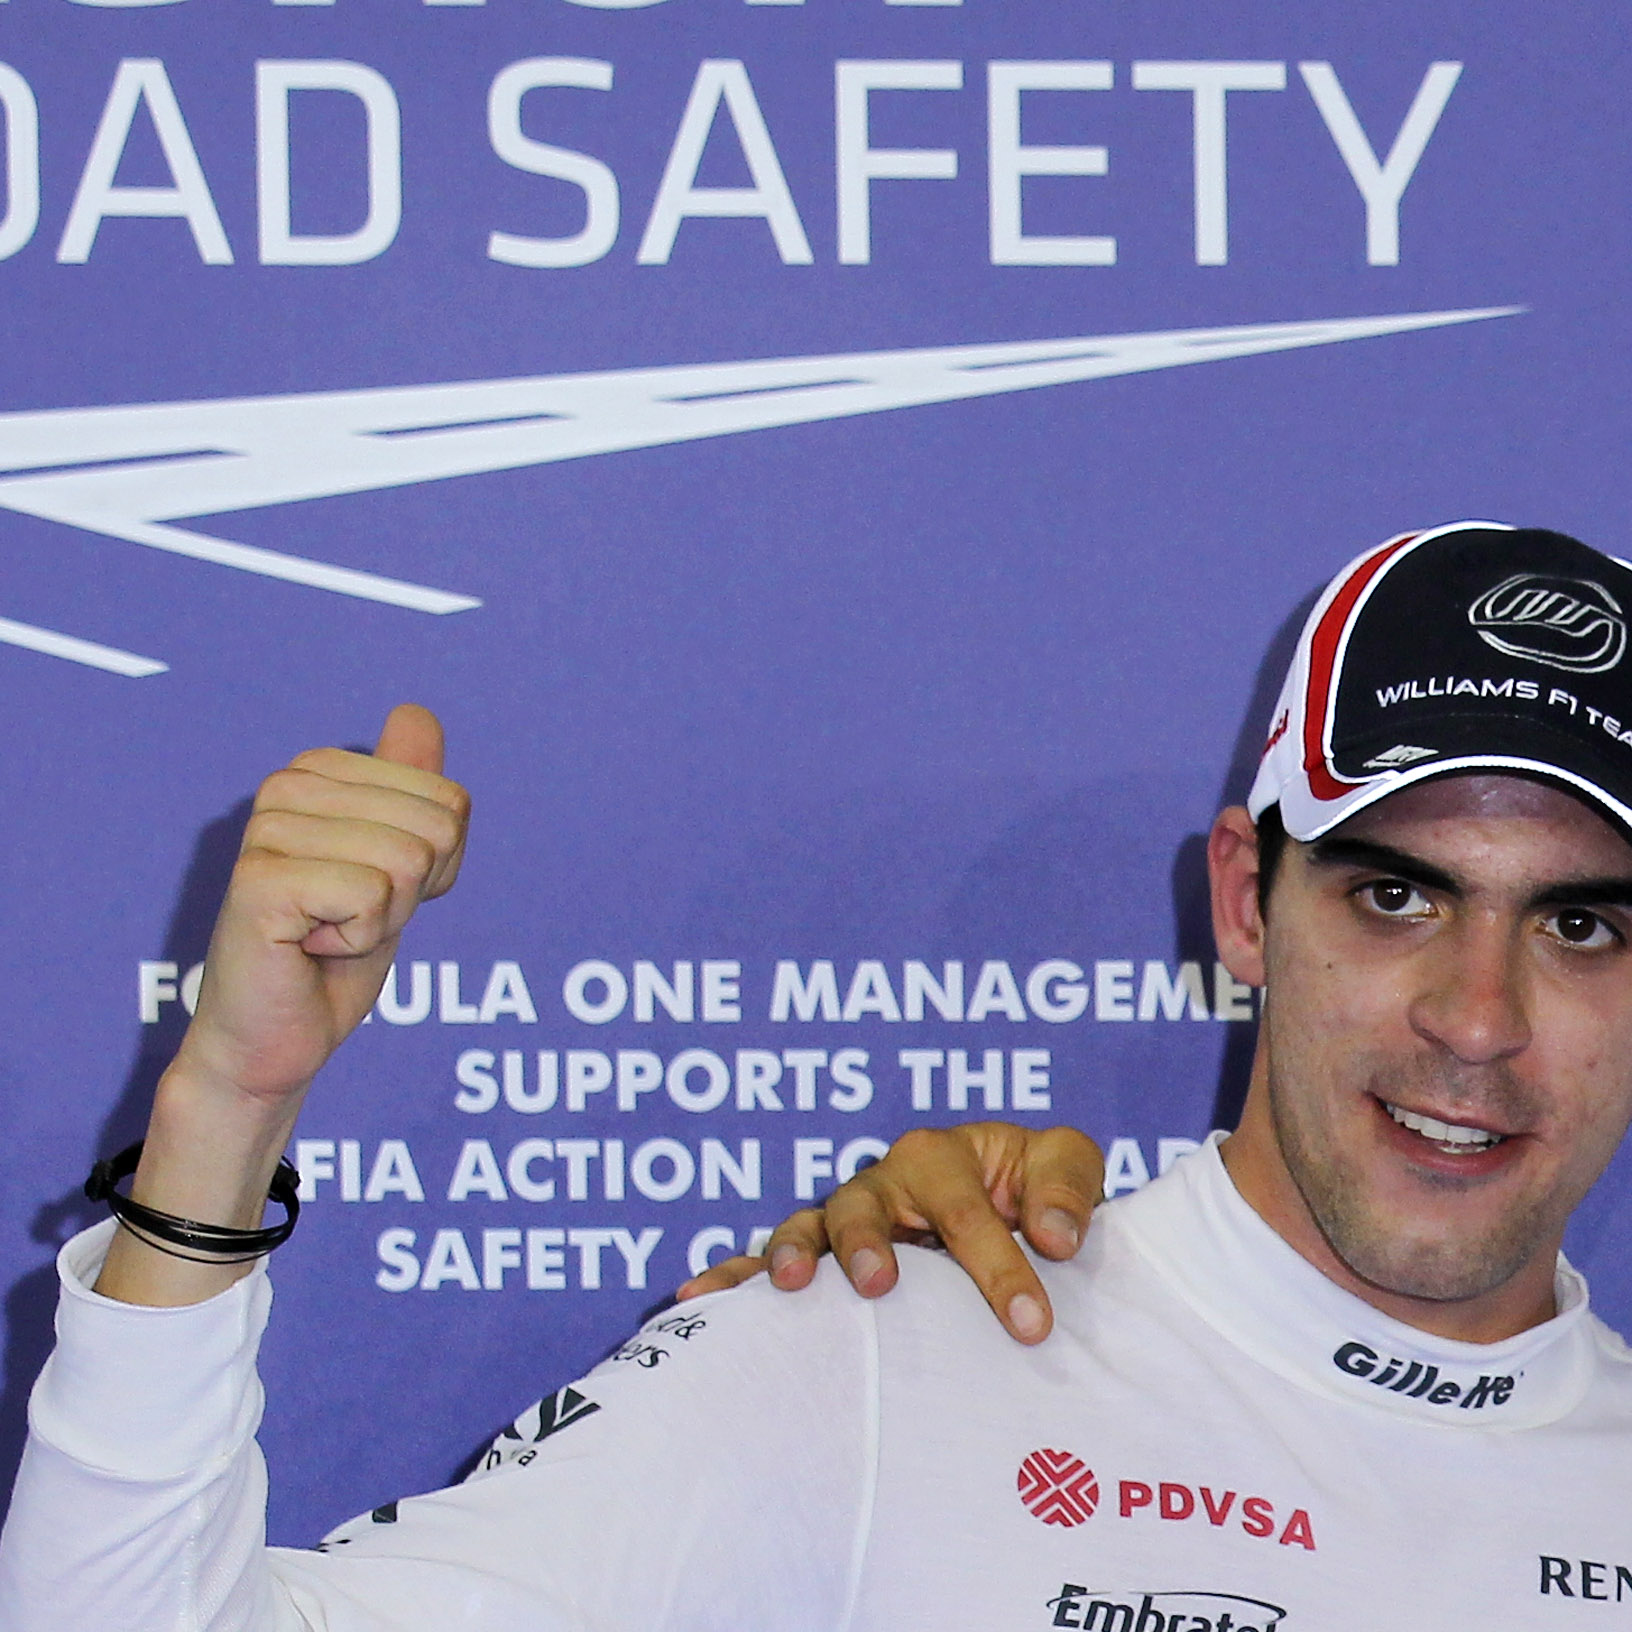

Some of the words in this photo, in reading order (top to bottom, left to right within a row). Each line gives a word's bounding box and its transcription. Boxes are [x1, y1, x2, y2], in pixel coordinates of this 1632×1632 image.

[485, 58, 1464, 267] SAFETY
[1376, 675, 1540, 709] WILLIAMS
[1548, 688, 1578, 716] F1
[562, 959, 743, 1026] ONE
[453, 1048, 873, 1114] SUPPORTS
[899, 1048, 1053, 1112] THE
[298, 1138, 425, 1203] FIA
[447, 1137, 763, 1203] ACTION
[375, 1226, 665, 1293] SAFETY
[1119, 1479, 1318, 1552] PDVSA
